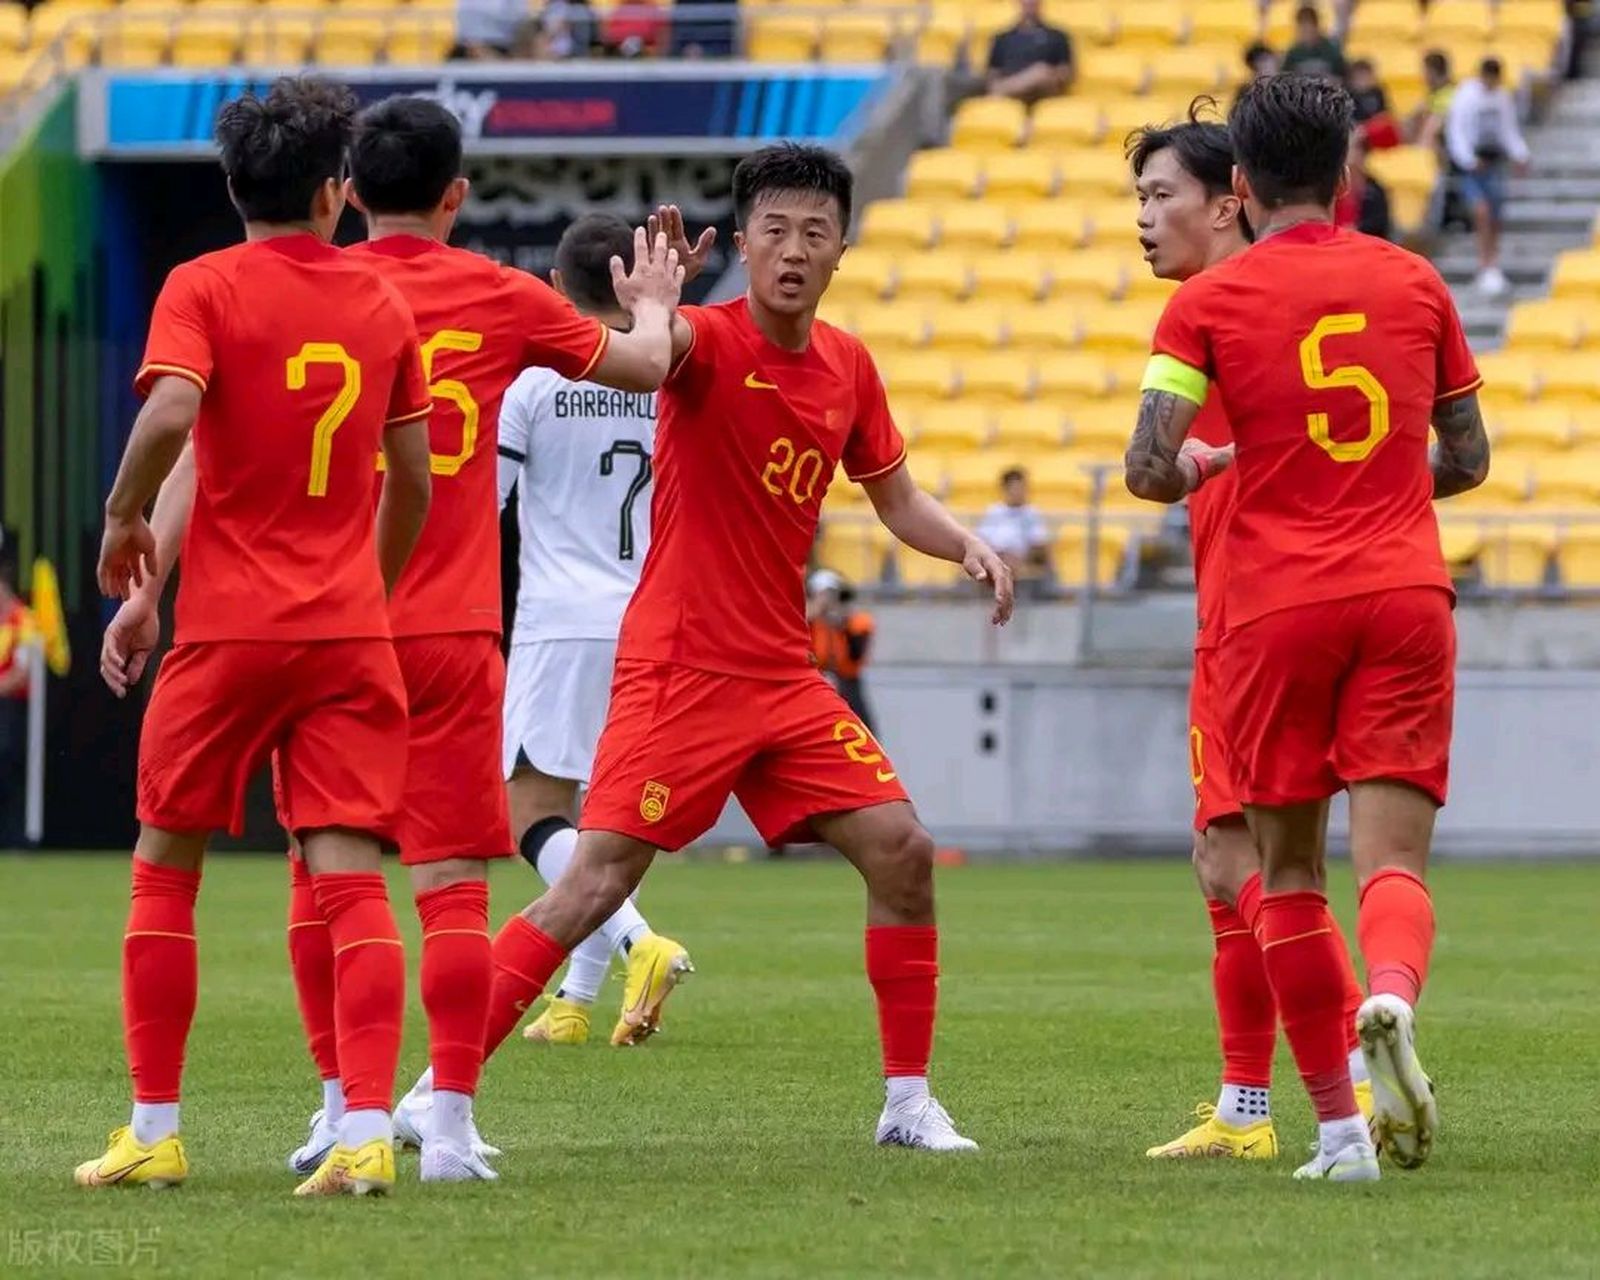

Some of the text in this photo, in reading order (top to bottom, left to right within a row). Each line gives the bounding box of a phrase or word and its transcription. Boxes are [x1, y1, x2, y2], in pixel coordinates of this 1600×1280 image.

[286, 342, 361, 497] 7
[1299, 313, 1389, 463] 5
[600, 440, 653, 561] 7
[761, 437, 823, 504] 20
